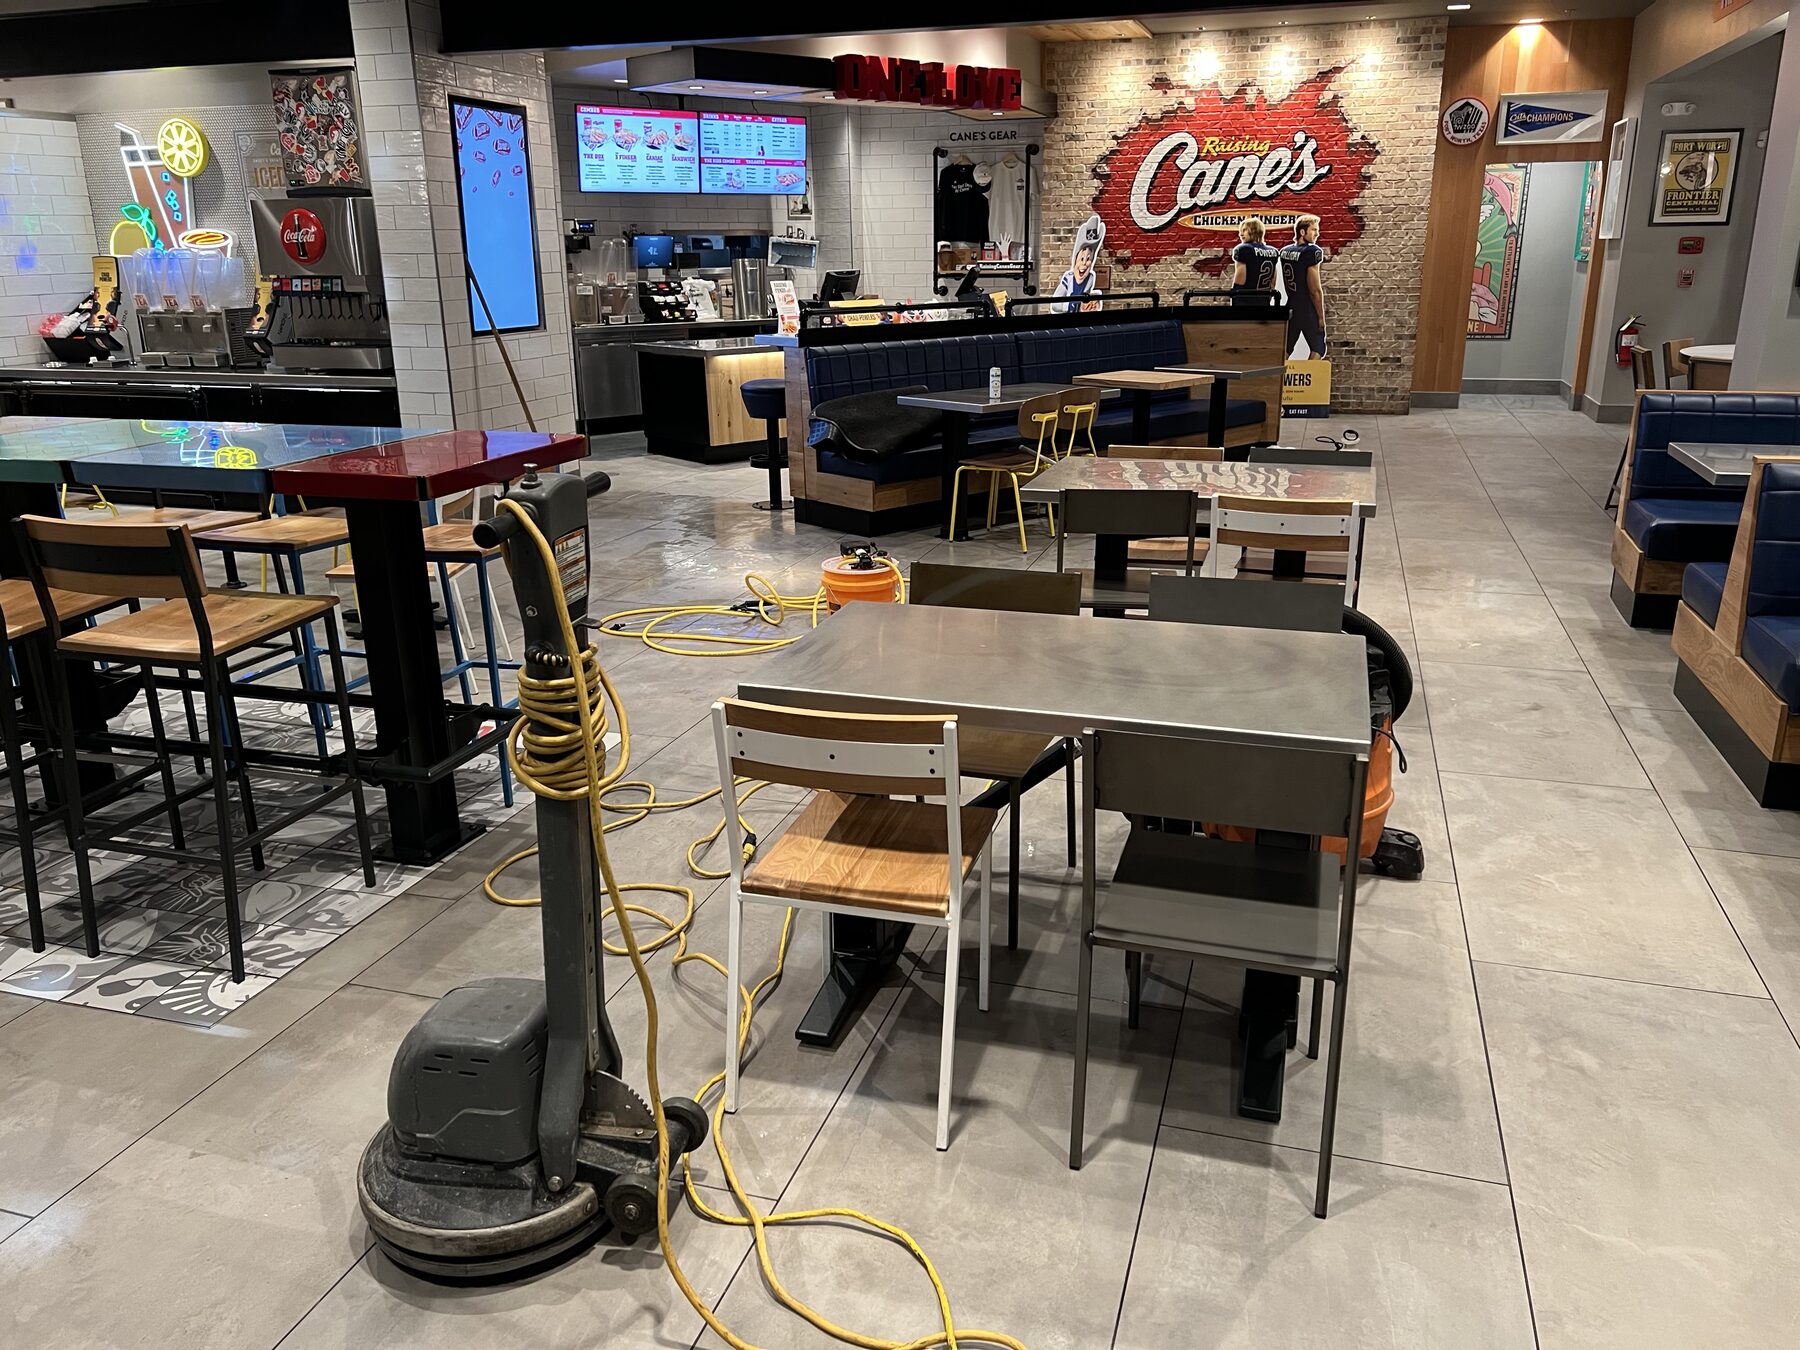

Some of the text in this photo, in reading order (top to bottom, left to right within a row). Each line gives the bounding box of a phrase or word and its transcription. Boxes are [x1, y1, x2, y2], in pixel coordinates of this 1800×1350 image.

[833, 53, 1021, 110] ONE LOVE
[1526, 112, 1574, 122] CHAMPIONS
[950, 130, 1017, 142] CANE'S GEAR
[1472, 121, 1486, 139] TEXAS
[1201, 136, 1270, 156] Raising
[1674, 141, 1728, 152] FORT WORTH
[1130, 131, 1332, 231] Cane's
[1666, 190, 1719, 200] FRONTIER
[1194, 214, 1302, 226] CHICKEN FINGER
[1284, 374, 1312, 386] WERS
